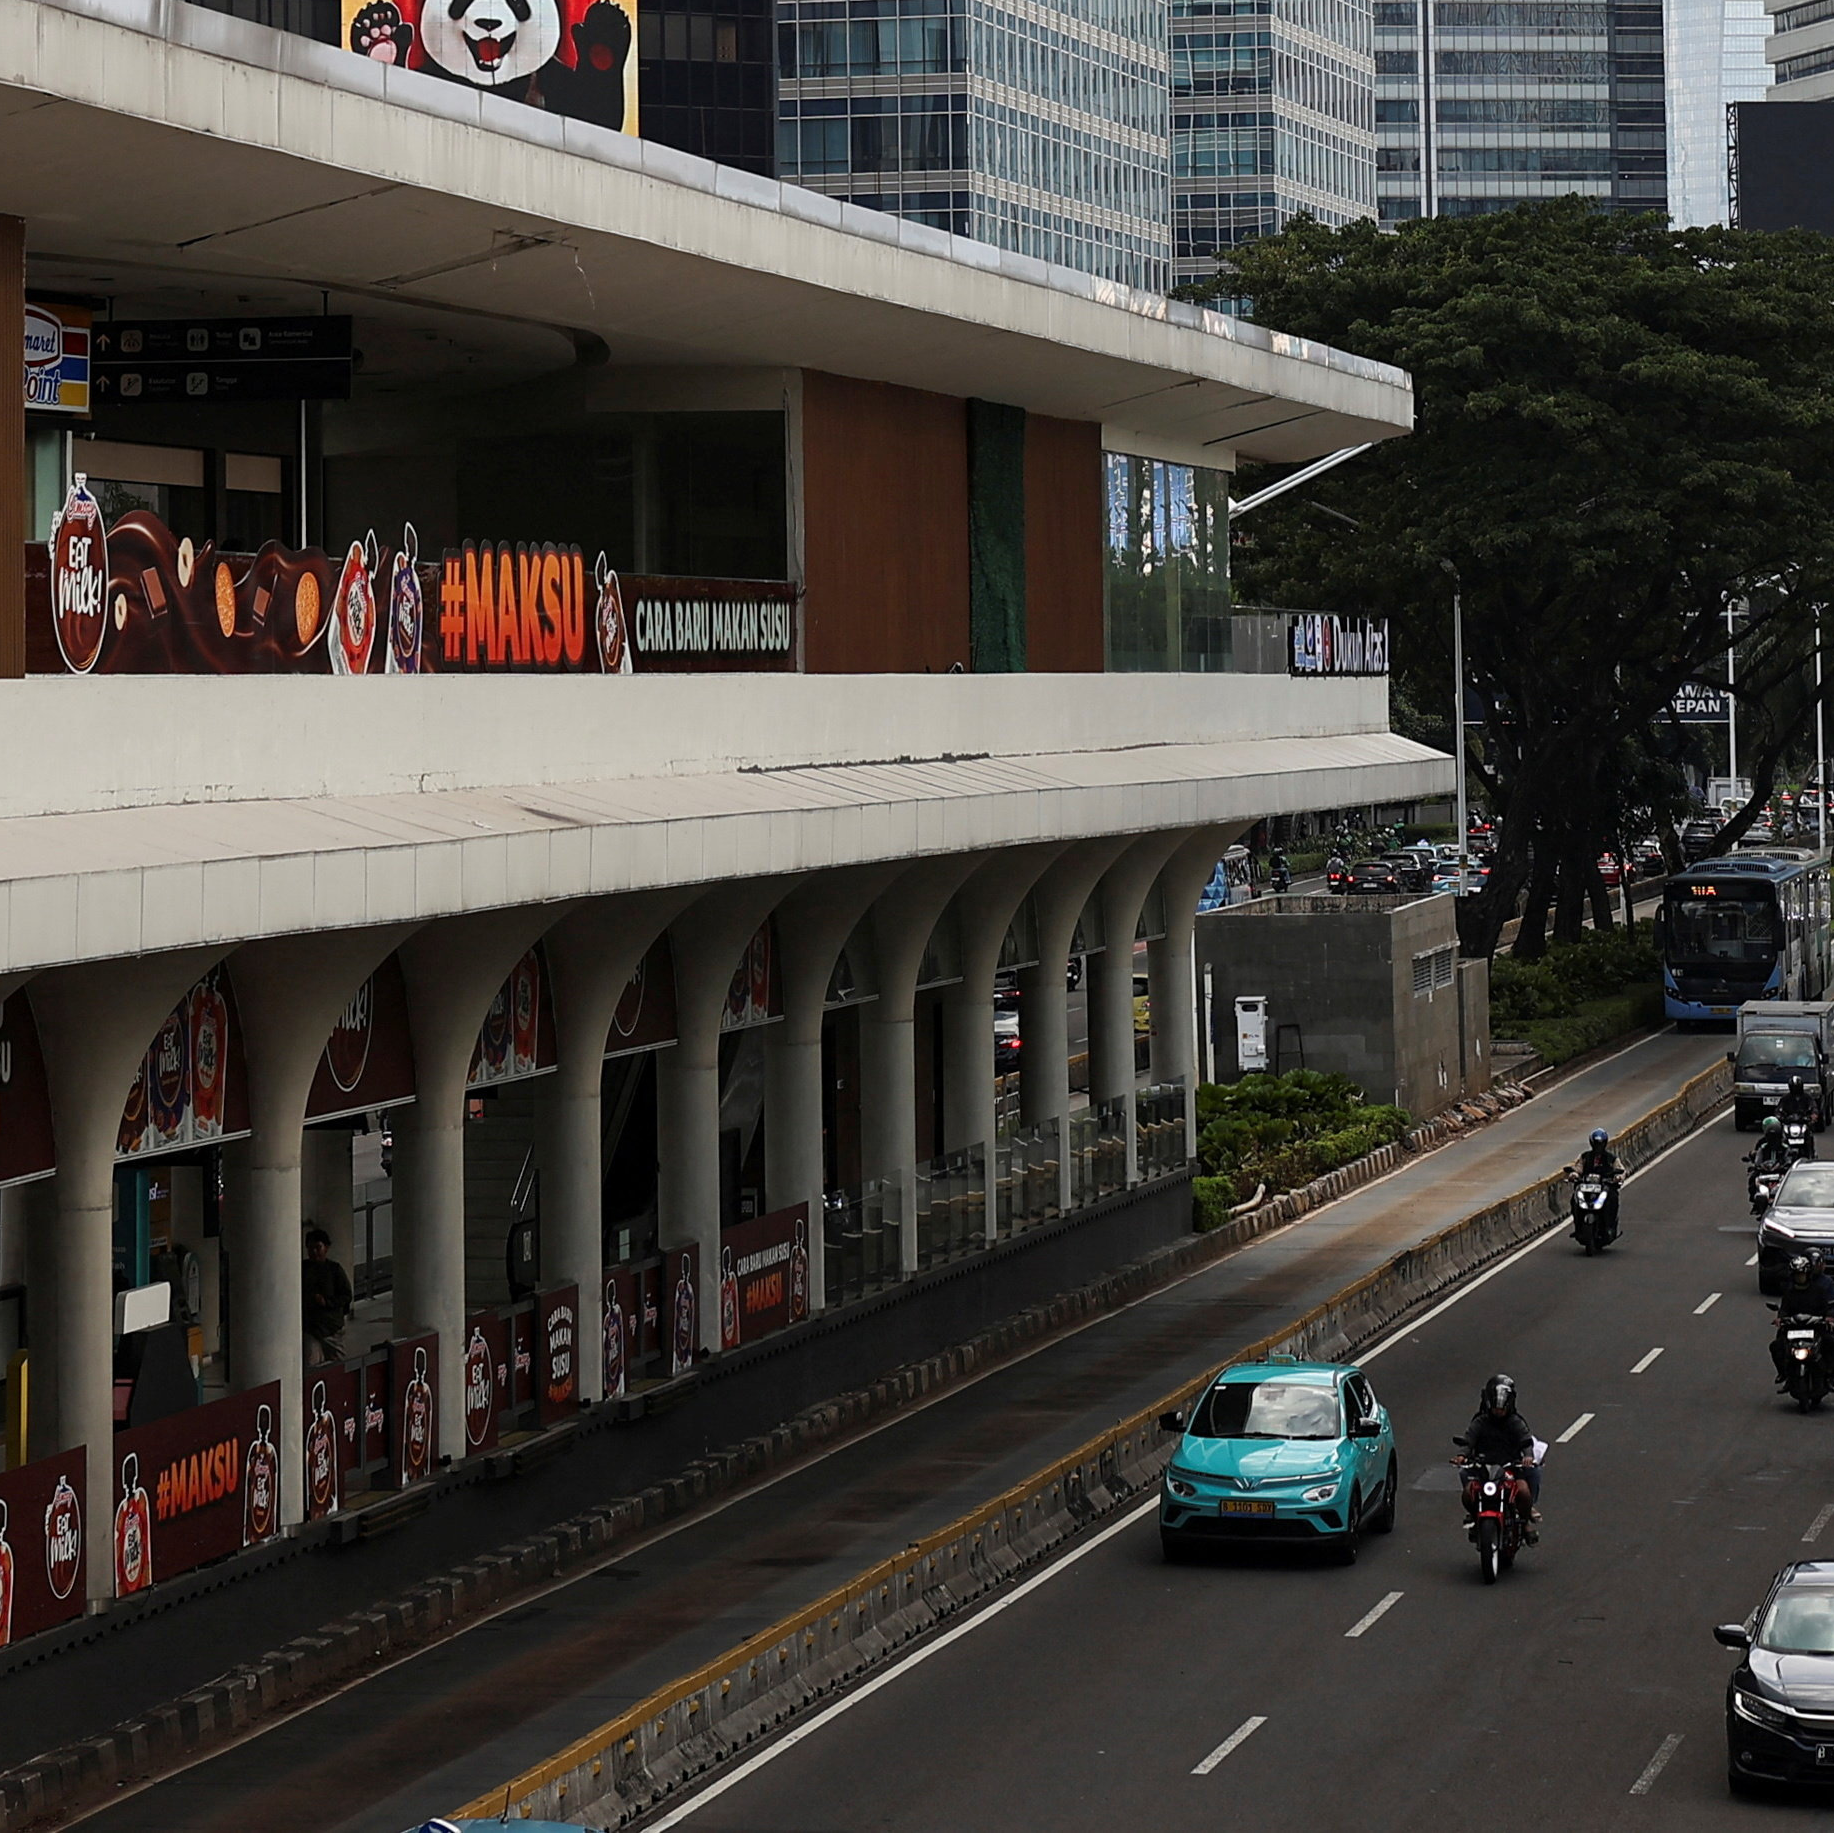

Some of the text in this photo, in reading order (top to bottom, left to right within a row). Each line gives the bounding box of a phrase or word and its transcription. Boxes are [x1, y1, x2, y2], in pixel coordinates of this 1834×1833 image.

[25, 331, 56, 353] maret
[69, 536, 92, 567] EAT
[441, 549, 585, 665] #MAKSU
[636, 599, 672, 653] CARA
[675, 600, 709, 652] BARU
[711, 601, 759, 651] MAKAN
[760, 602, 790, 651] SUSU
[1334, 615, 1363, 672] Dukuh
[1384, 618, 1389, 672] 1
[1670, 699, 1720, 714] EPAN
[552, 1351, 571, 1380] SUSU
[156, 1437, 239, 1522] #MAKSU
[1818, 1746, 1825, 1759] B
